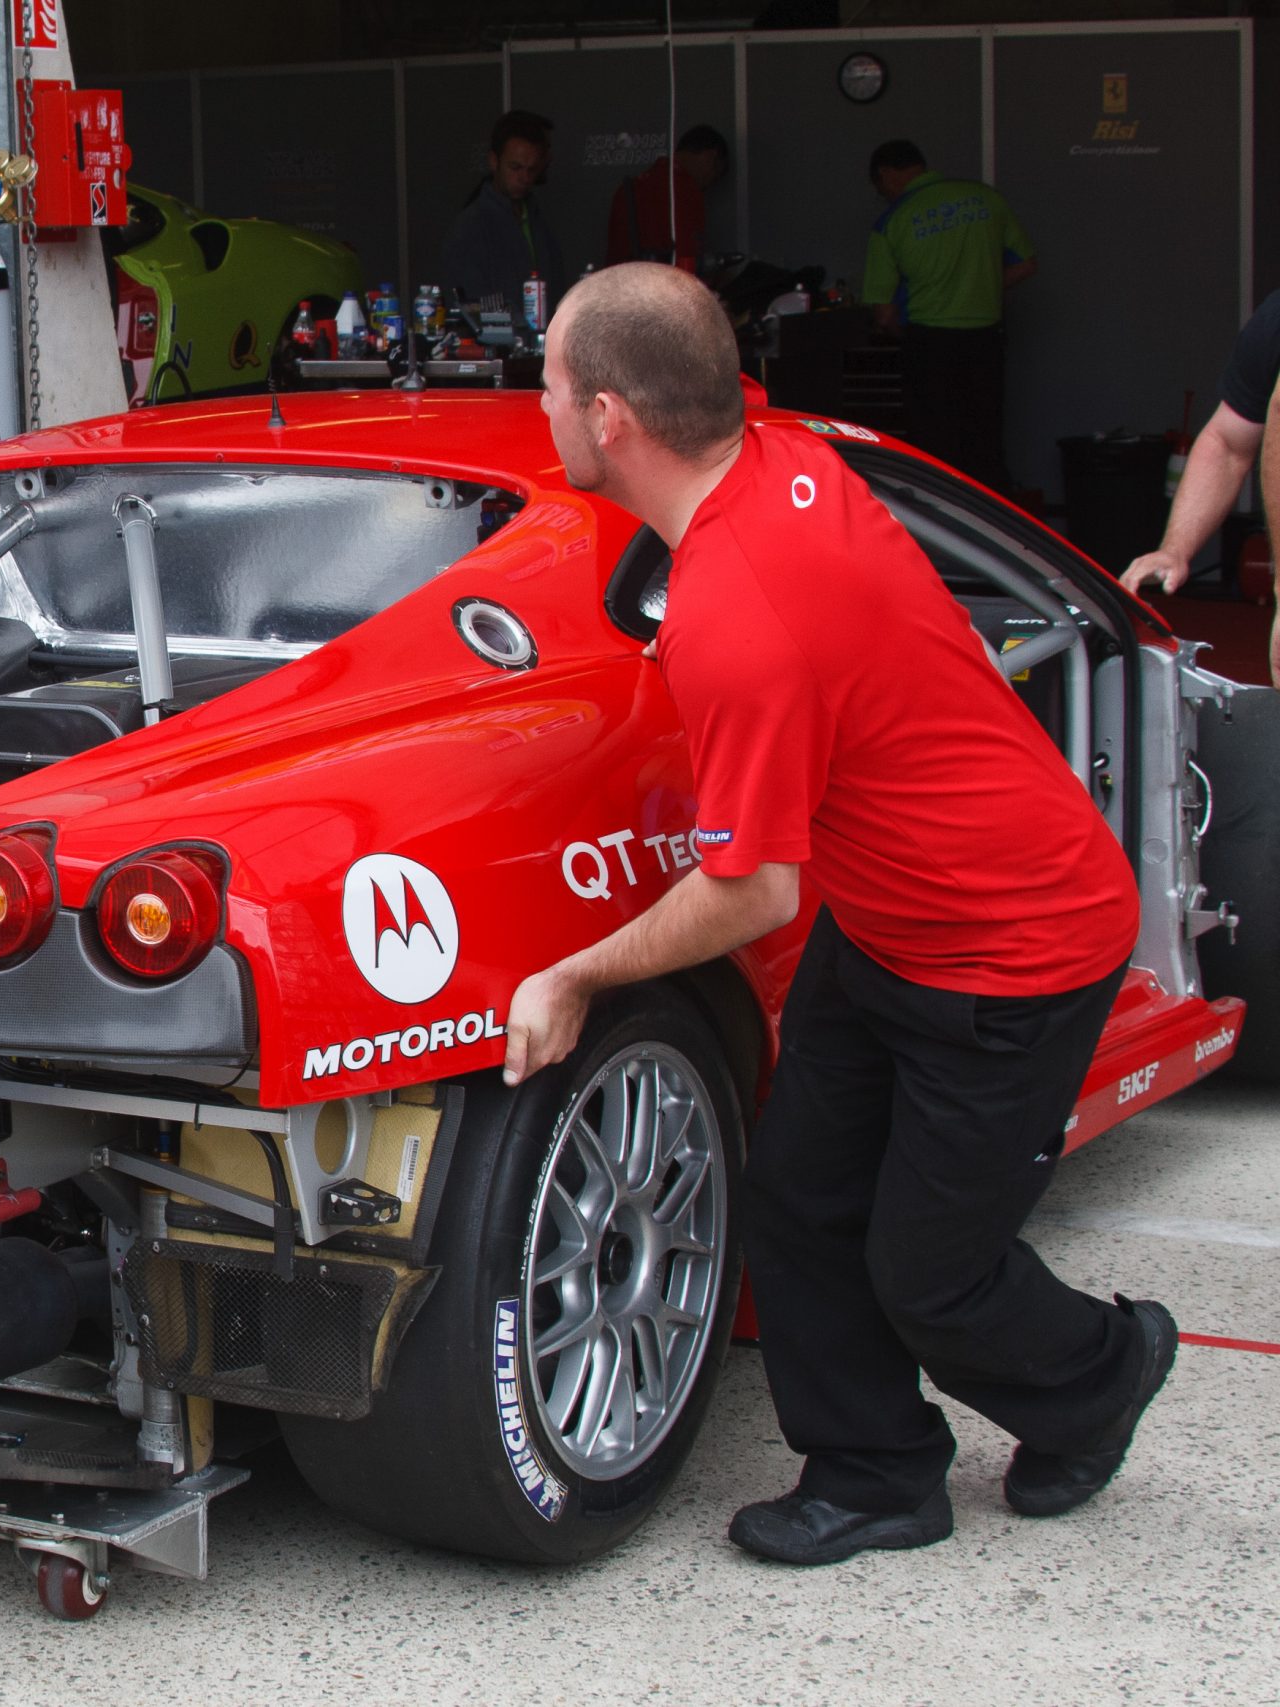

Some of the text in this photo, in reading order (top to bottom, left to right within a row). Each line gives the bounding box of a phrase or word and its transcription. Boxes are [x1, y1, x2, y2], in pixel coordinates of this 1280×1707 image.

[562, 828, 637, 900] QT
[302, 1008, 507, 1081] MOTOROL
[1194, 1027, 1235, 1063] brembo
[1117, 1061, 1160, 1105] SKF
[490, 1308, 544, 1492] MICHELIN
